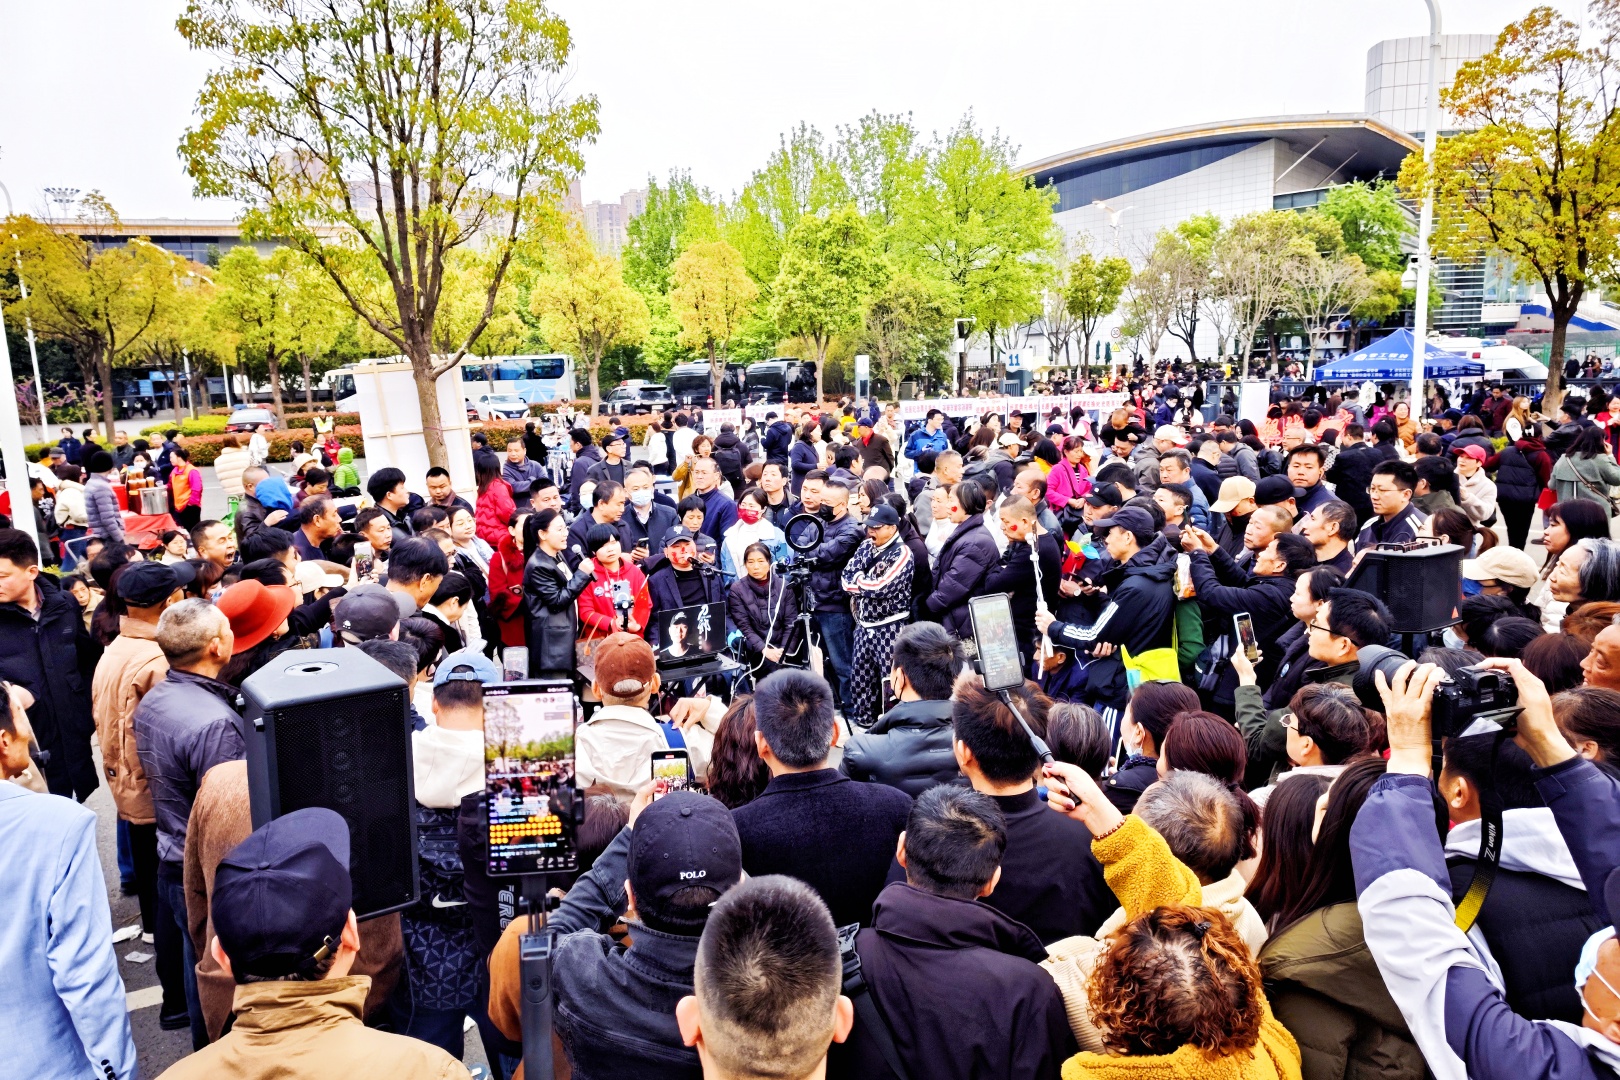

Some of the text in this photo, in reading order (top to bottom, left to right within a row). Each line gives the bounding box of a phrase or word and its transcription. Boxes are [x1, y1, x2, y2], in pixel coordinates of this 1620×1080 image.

[1009, 354, 1020, 366] 11
[1484, 822, 1496, 861] Nikon Z
[680, 870, 706, 880] POLO
